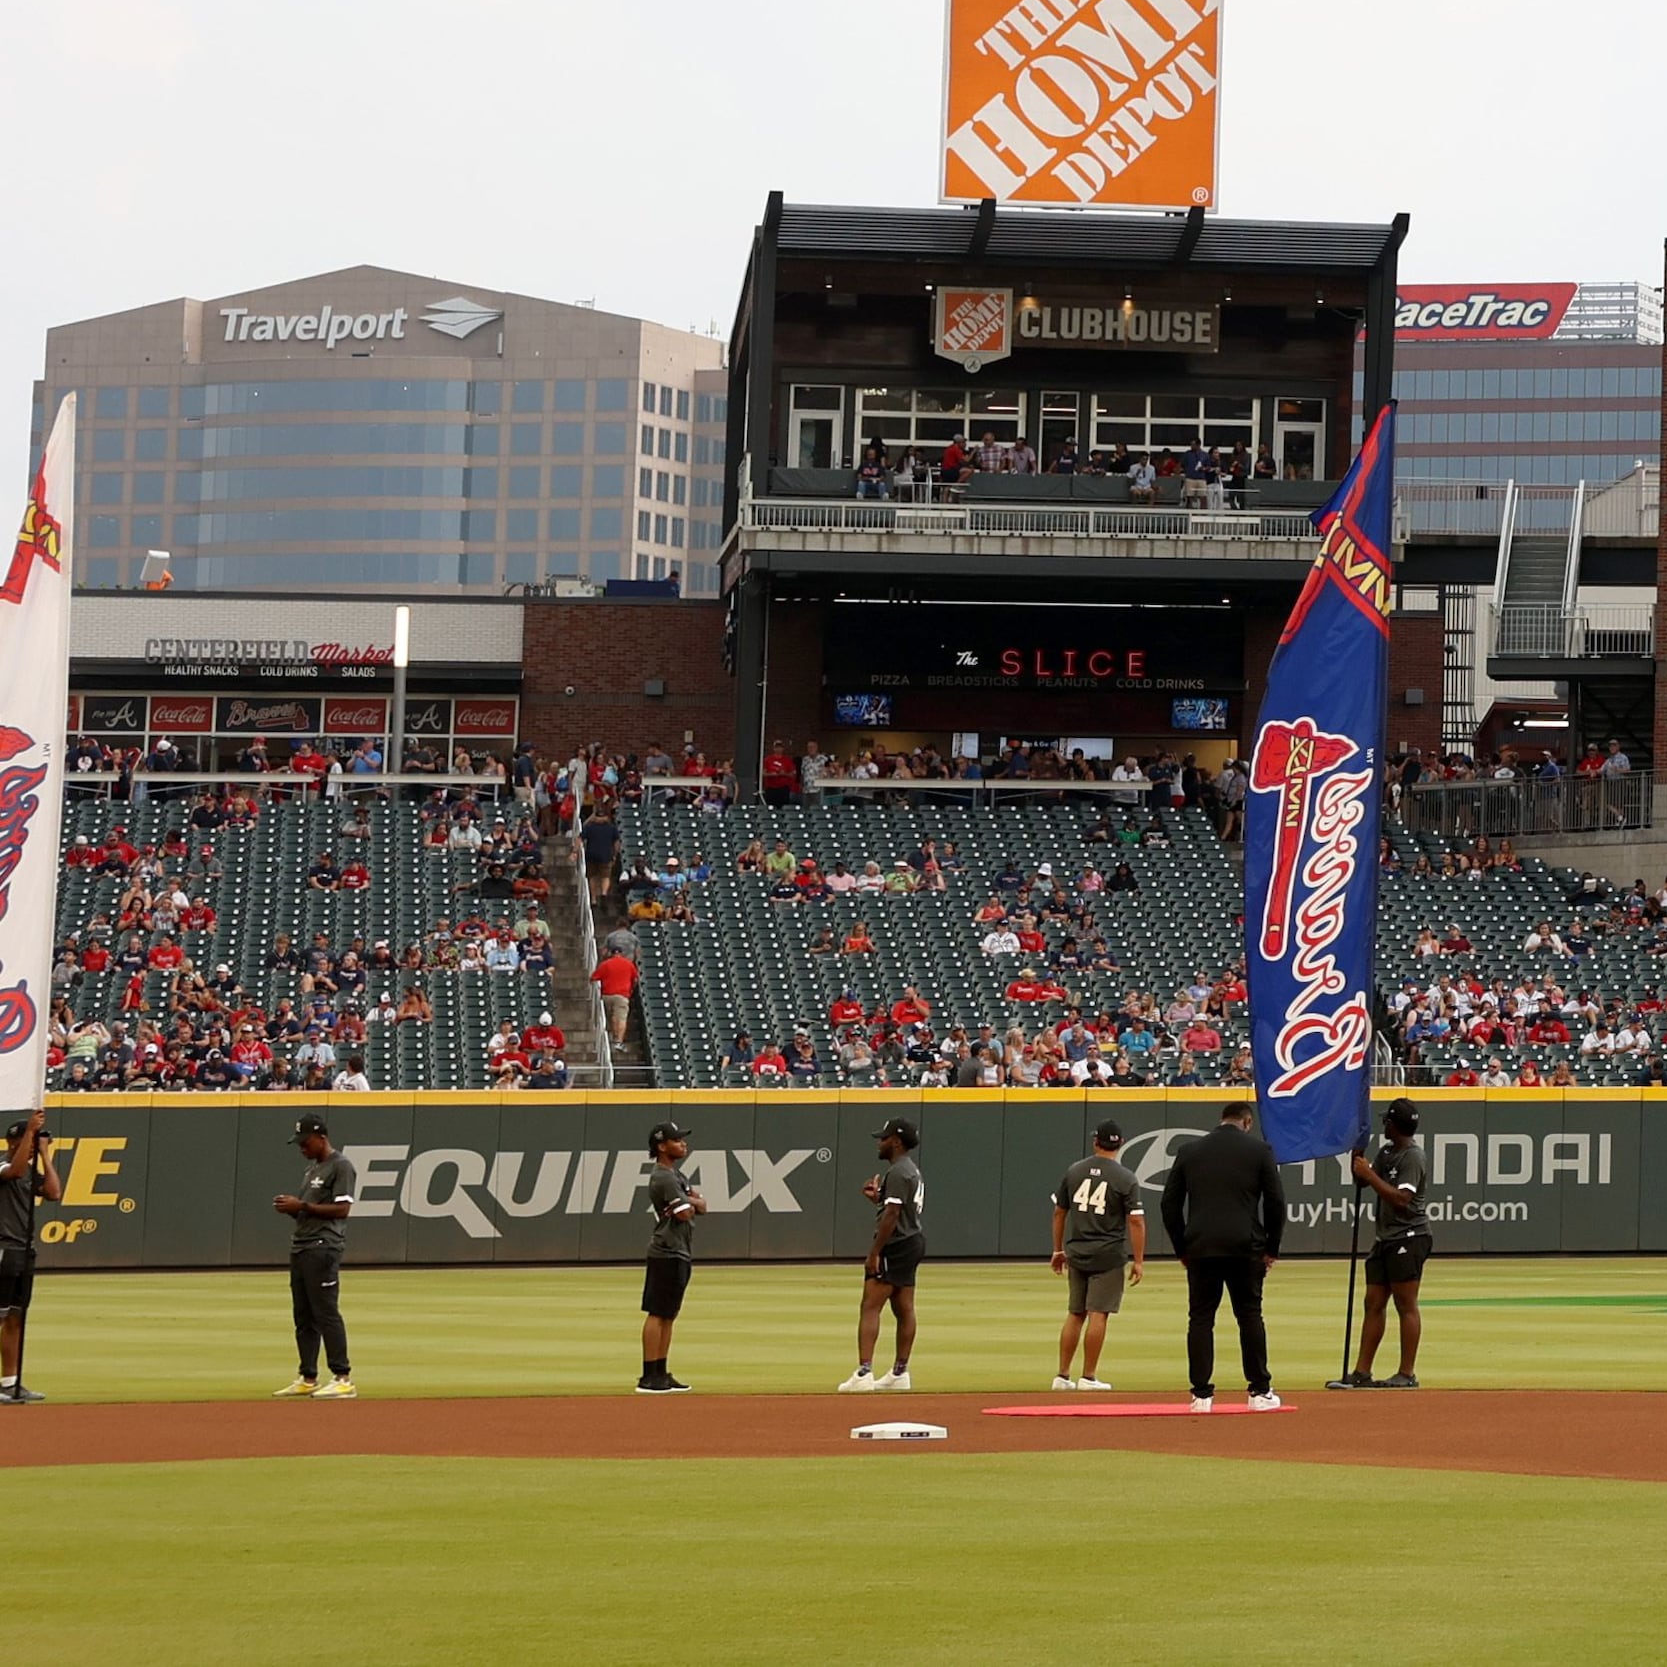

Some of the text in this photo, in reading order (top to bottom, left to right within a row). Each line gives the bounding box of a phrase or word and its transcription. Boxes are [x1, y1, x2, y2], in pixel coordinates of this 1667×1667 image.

[1050, 42, 1218, 205] DEPOT
[942, 293, 1005, 351] HOME
[951, 298, 976, 323] THE
[1019, 306, 1213, 344] CLUBHOUSE
[1394, 294, 1549, 329] aceTrac
[219, 304, 408, 349] Travelport
[967, 317, 1006, 352] DEPOT
[144, 638, 395, 669] CENTERFIELD Market
[956, 649, 1146, 678] The SLICE
[164, 664, 239, 676] HEALTHY SNACKS
[260, 665, 318, 677] COLD DRINKS
[341, 666, 376, 678] SALADS
[870, 674, 910, 686] PIZZA
[927, 675, 1019, 687] BREADSTICKS
[1037, 677, 1098, 688] PEANUTS
[1116, 678, 1204, 690] COLD DRINKS
[1073, 1178, 1108, 1216] 44
